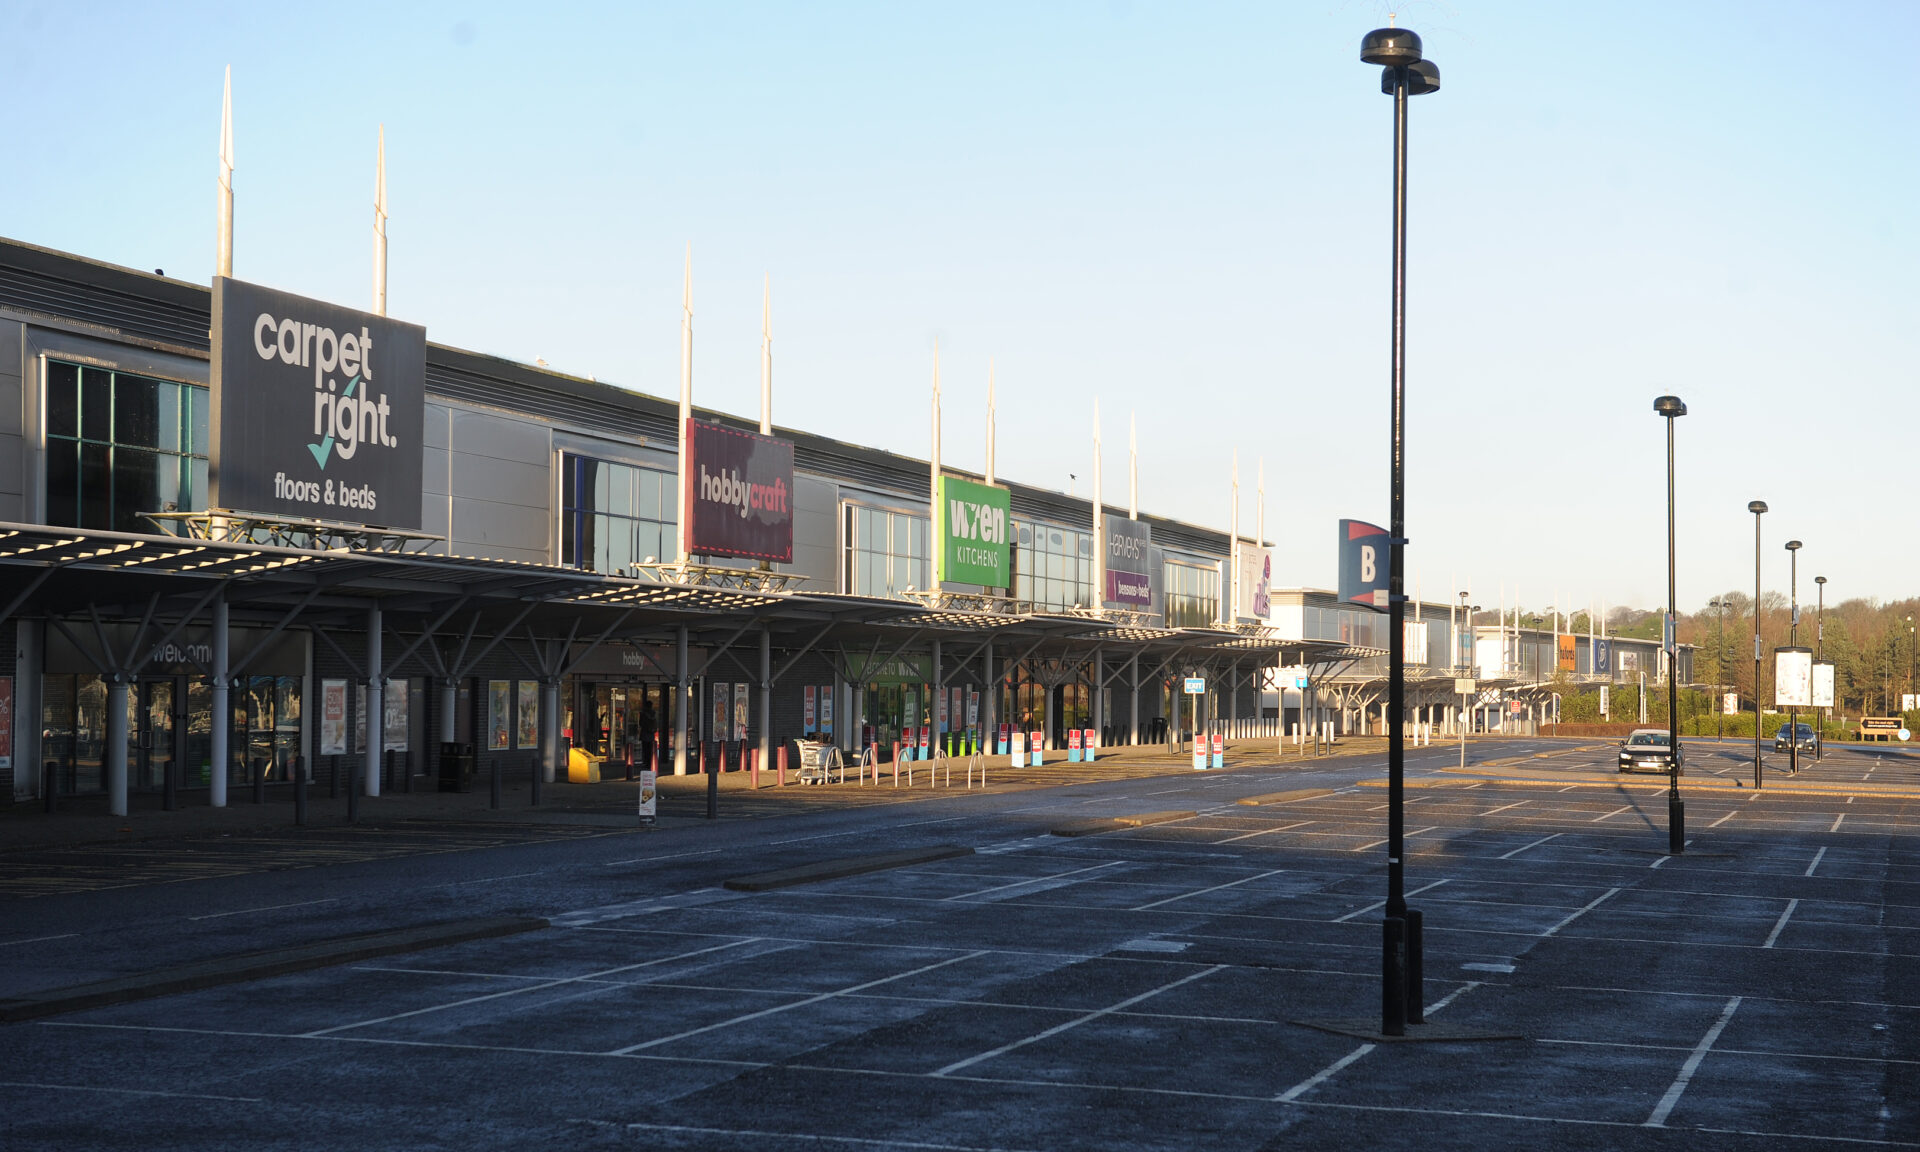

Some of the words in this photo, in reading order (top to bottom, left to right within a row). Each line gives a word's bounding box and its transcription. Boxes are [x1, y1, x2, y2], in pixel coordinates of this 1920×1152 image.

[254, 313, 372, 389] carpet
[274, 472, 320, 505] floors
[324, 479, 335, 505] &
[340, 481, 376, 510] beds
[700, 464, 786, 519] hobbycraft
[950, 500, 1005, 544] wren
[957, 546, 998, 568] KITCHENS
[1361, 545, 1376, 583] B
[623, 651, 661, 670] hobbyc
[1186, 682, 1202, 690] EXIT
